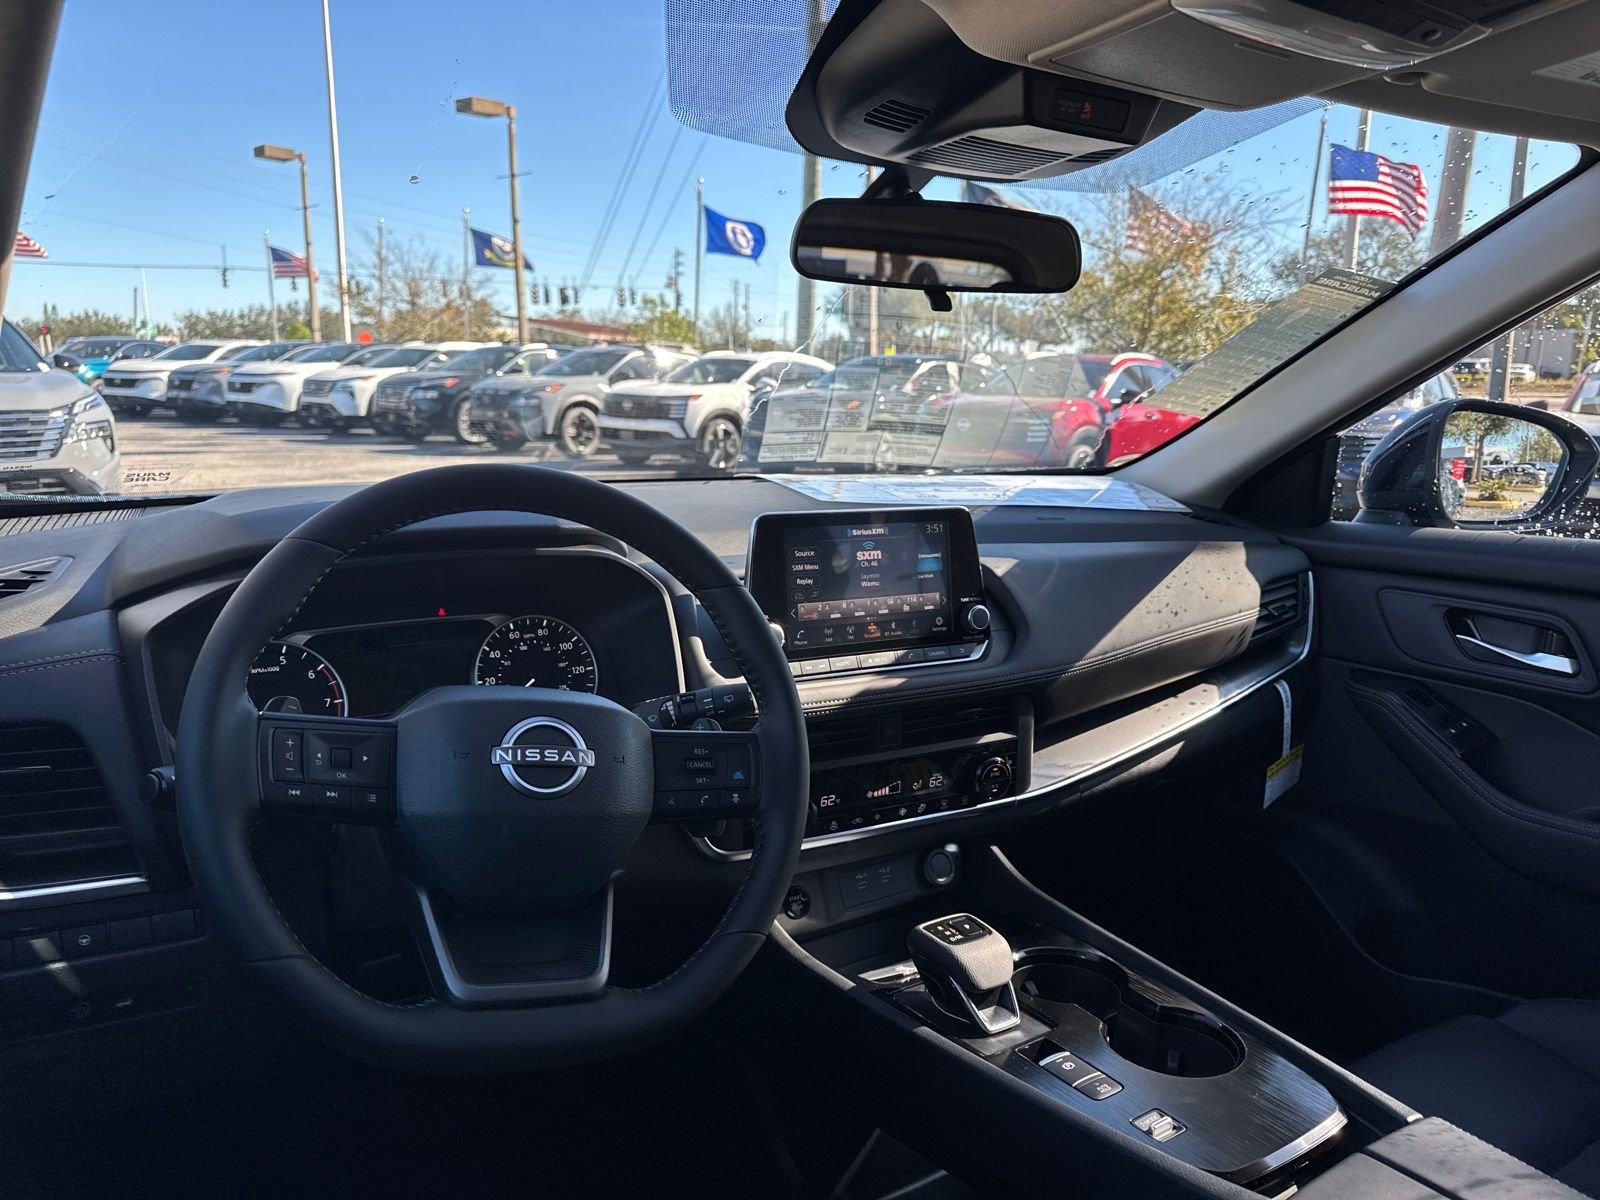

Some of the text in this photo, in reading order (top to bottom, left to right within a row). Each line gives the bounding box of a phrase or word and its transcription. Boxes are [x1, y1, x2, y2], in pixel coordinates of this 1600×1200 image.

[925, 524, 943, 533] 3:51
[509, 631, 520, 639] 60
[559, 642, 573, 650] 100
[280, 656, 287, 665] 5
[308, 670, 315, 679] 6
[572, 666, 585, 674] 120
[485, 677, 496, 686] 20
[324, 698, 331, 707] 7
[495, 749, 593, 764] NISSAN
